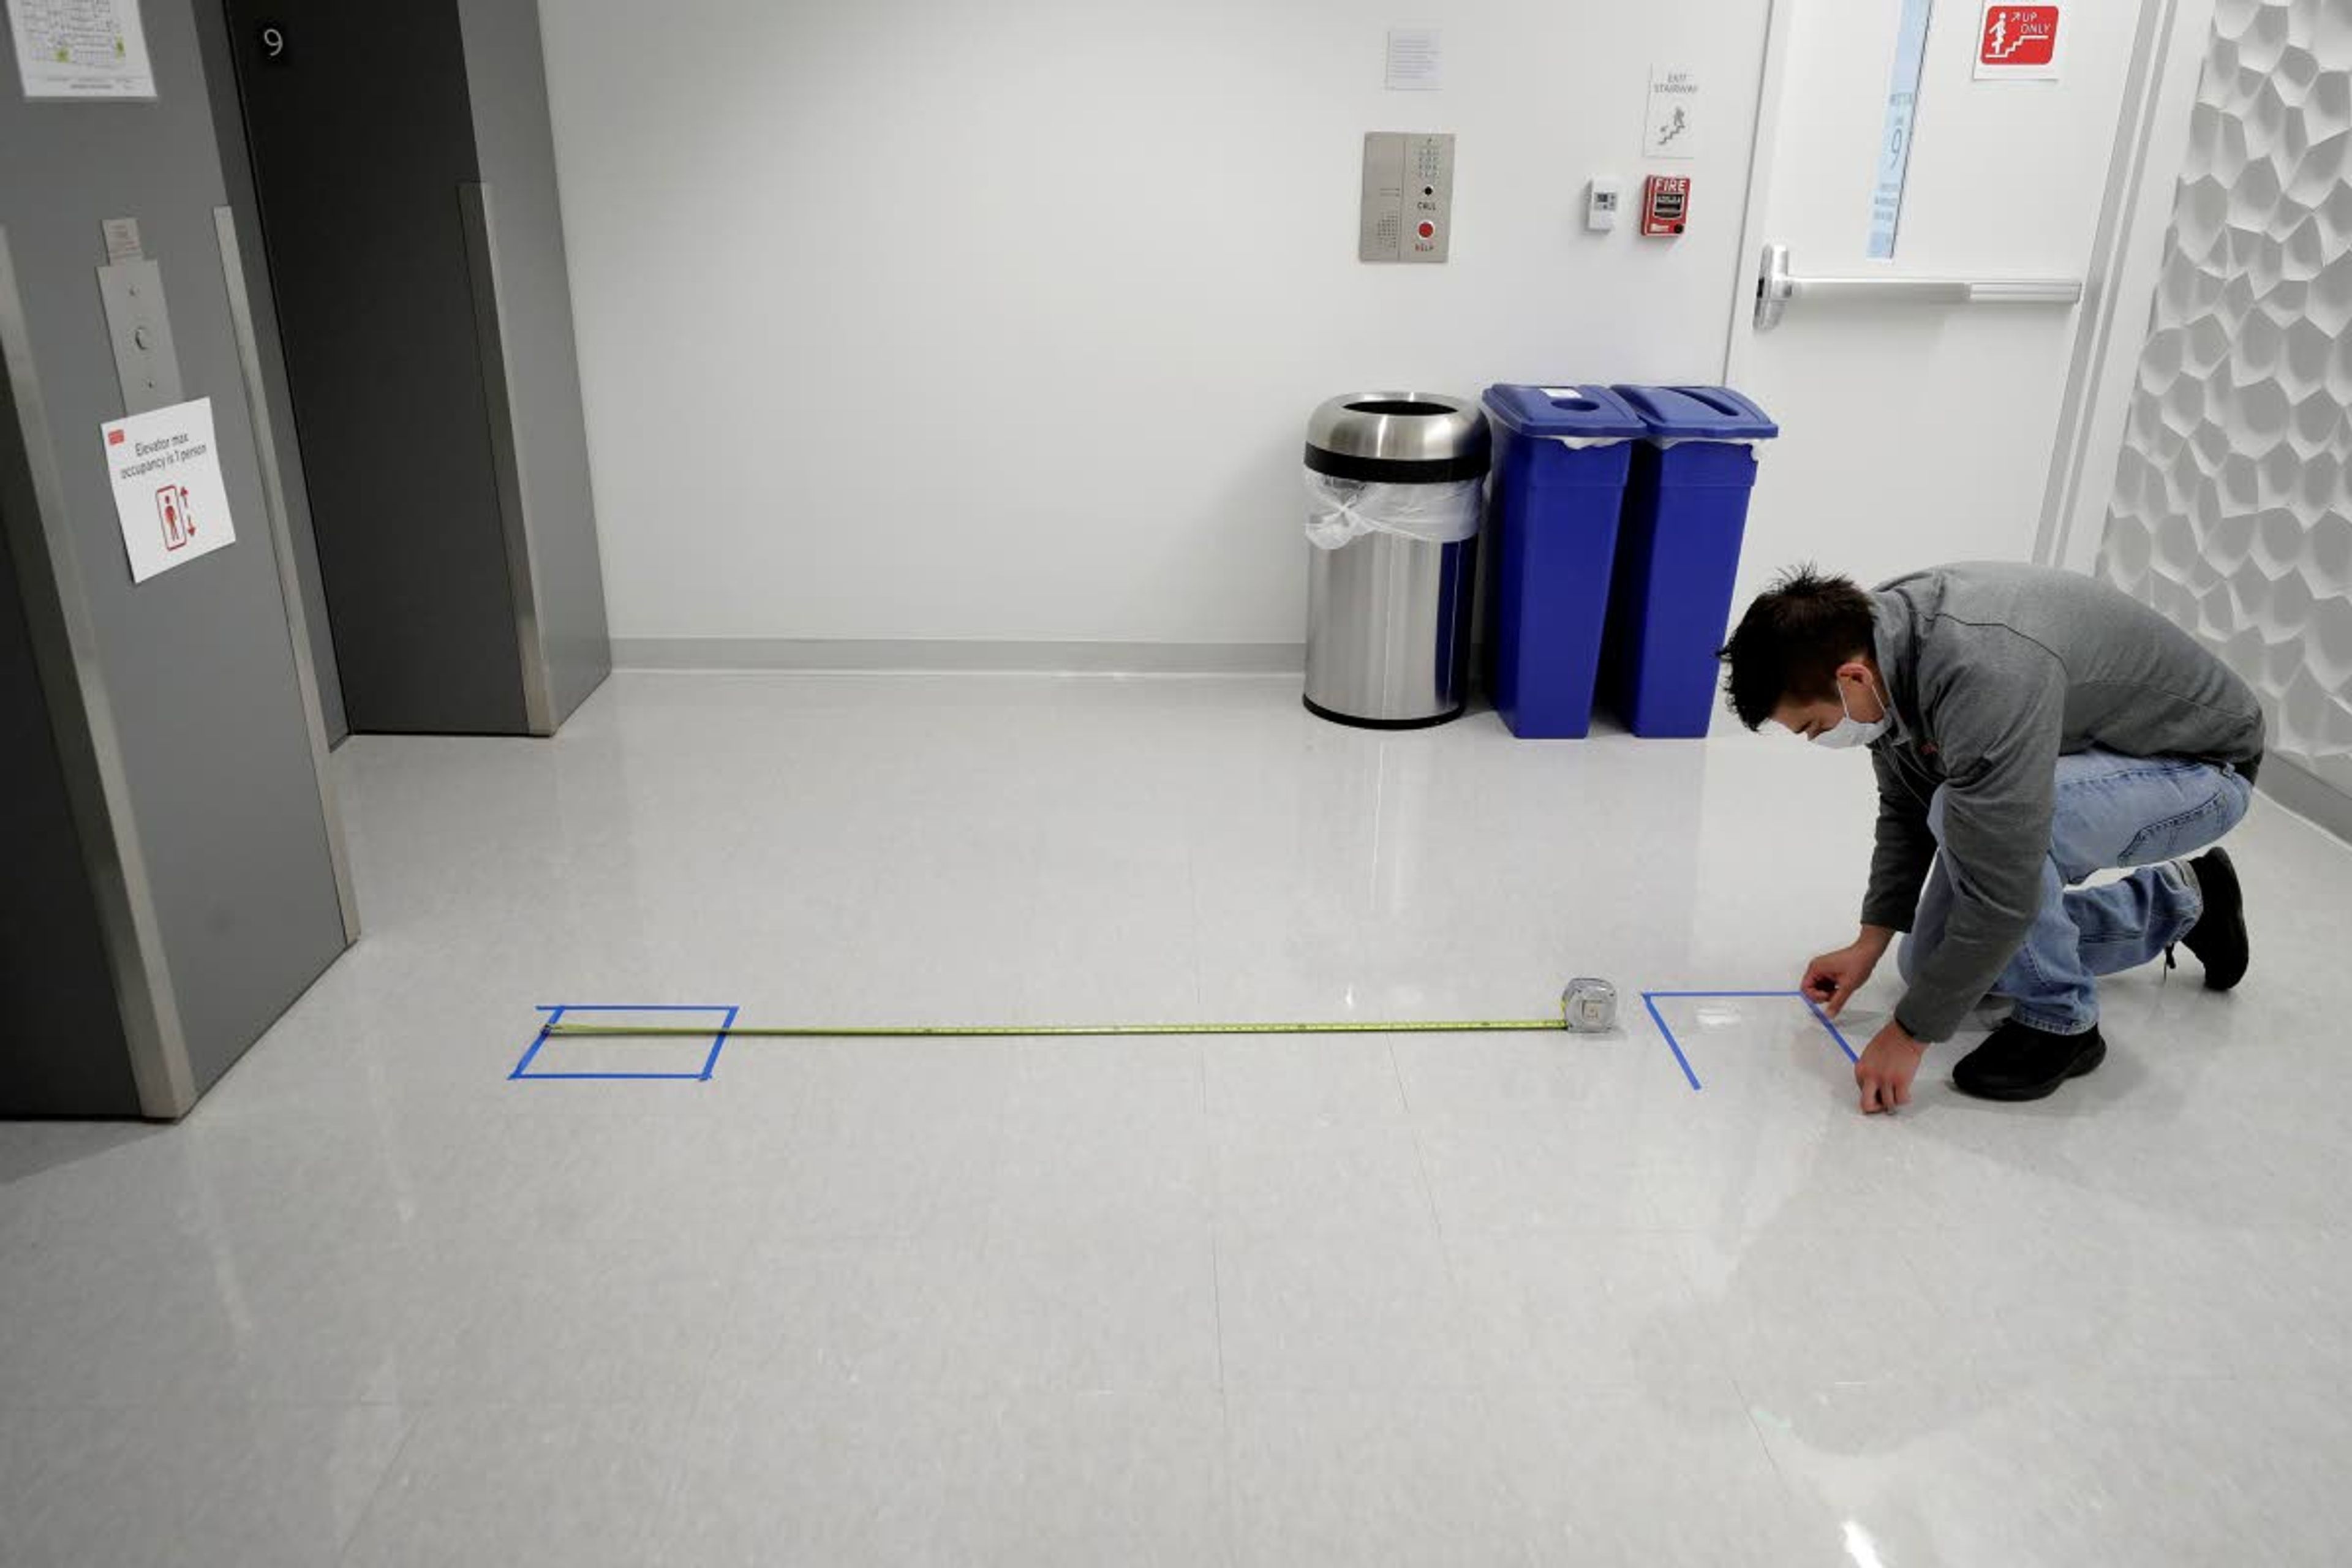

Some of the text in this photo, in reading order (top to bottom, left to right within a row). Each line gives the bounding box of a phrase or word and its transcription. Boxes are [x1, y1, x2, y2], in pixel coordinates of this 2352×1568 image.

[2022, 12, 2037, 22] UP
[2021, 23, 2051, 34] ONLY
[264, 29, 283, 56] 9
[1655, 178, 1686, 192] FIRE
[135, 434, 189, 456] Elevator max
[121, 456, 165, 479] occupancy
[167, 453, 174, 464] is
[181, 442, 206, 462] person
